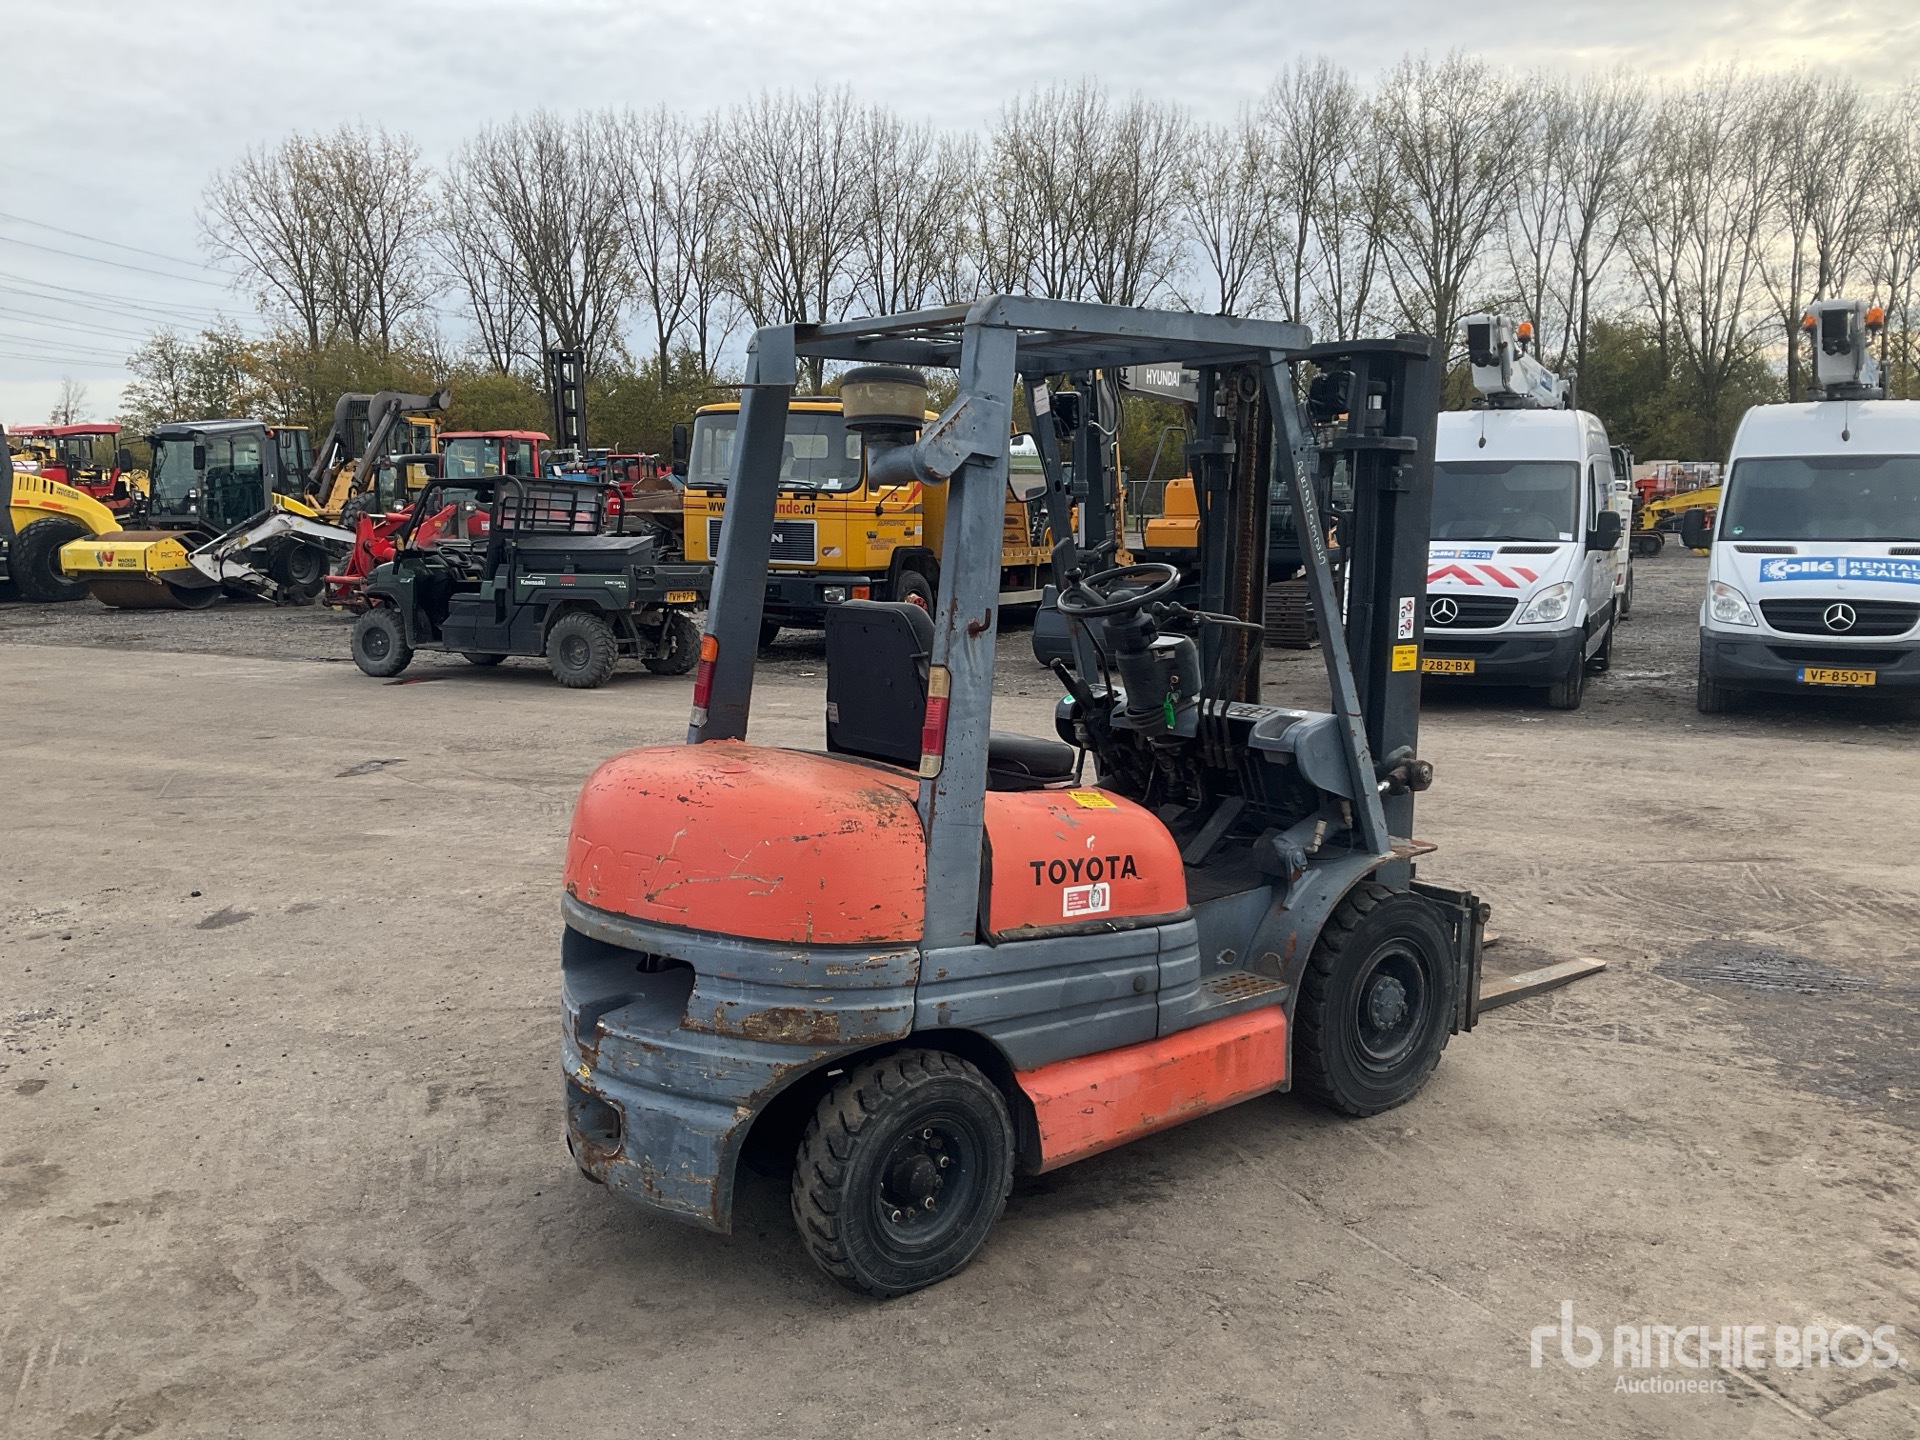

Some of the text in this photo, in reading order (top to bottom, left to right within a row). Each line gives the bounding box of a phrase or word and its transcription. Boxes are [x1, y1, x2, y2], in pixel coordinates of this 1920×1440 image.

[1146, 368, 1180, 387] HYUNDAI
[160, 550, 185, 558] RC70
[1765, 559, 1834, 578] Collé
[1850, 561, 1920, 572] RENTAL
[1866, 569, 1920, 579] SALES
[1810, 669, 1872, 683] VF-850-T
[1029, 854, 1138, 886] TOYOTA
